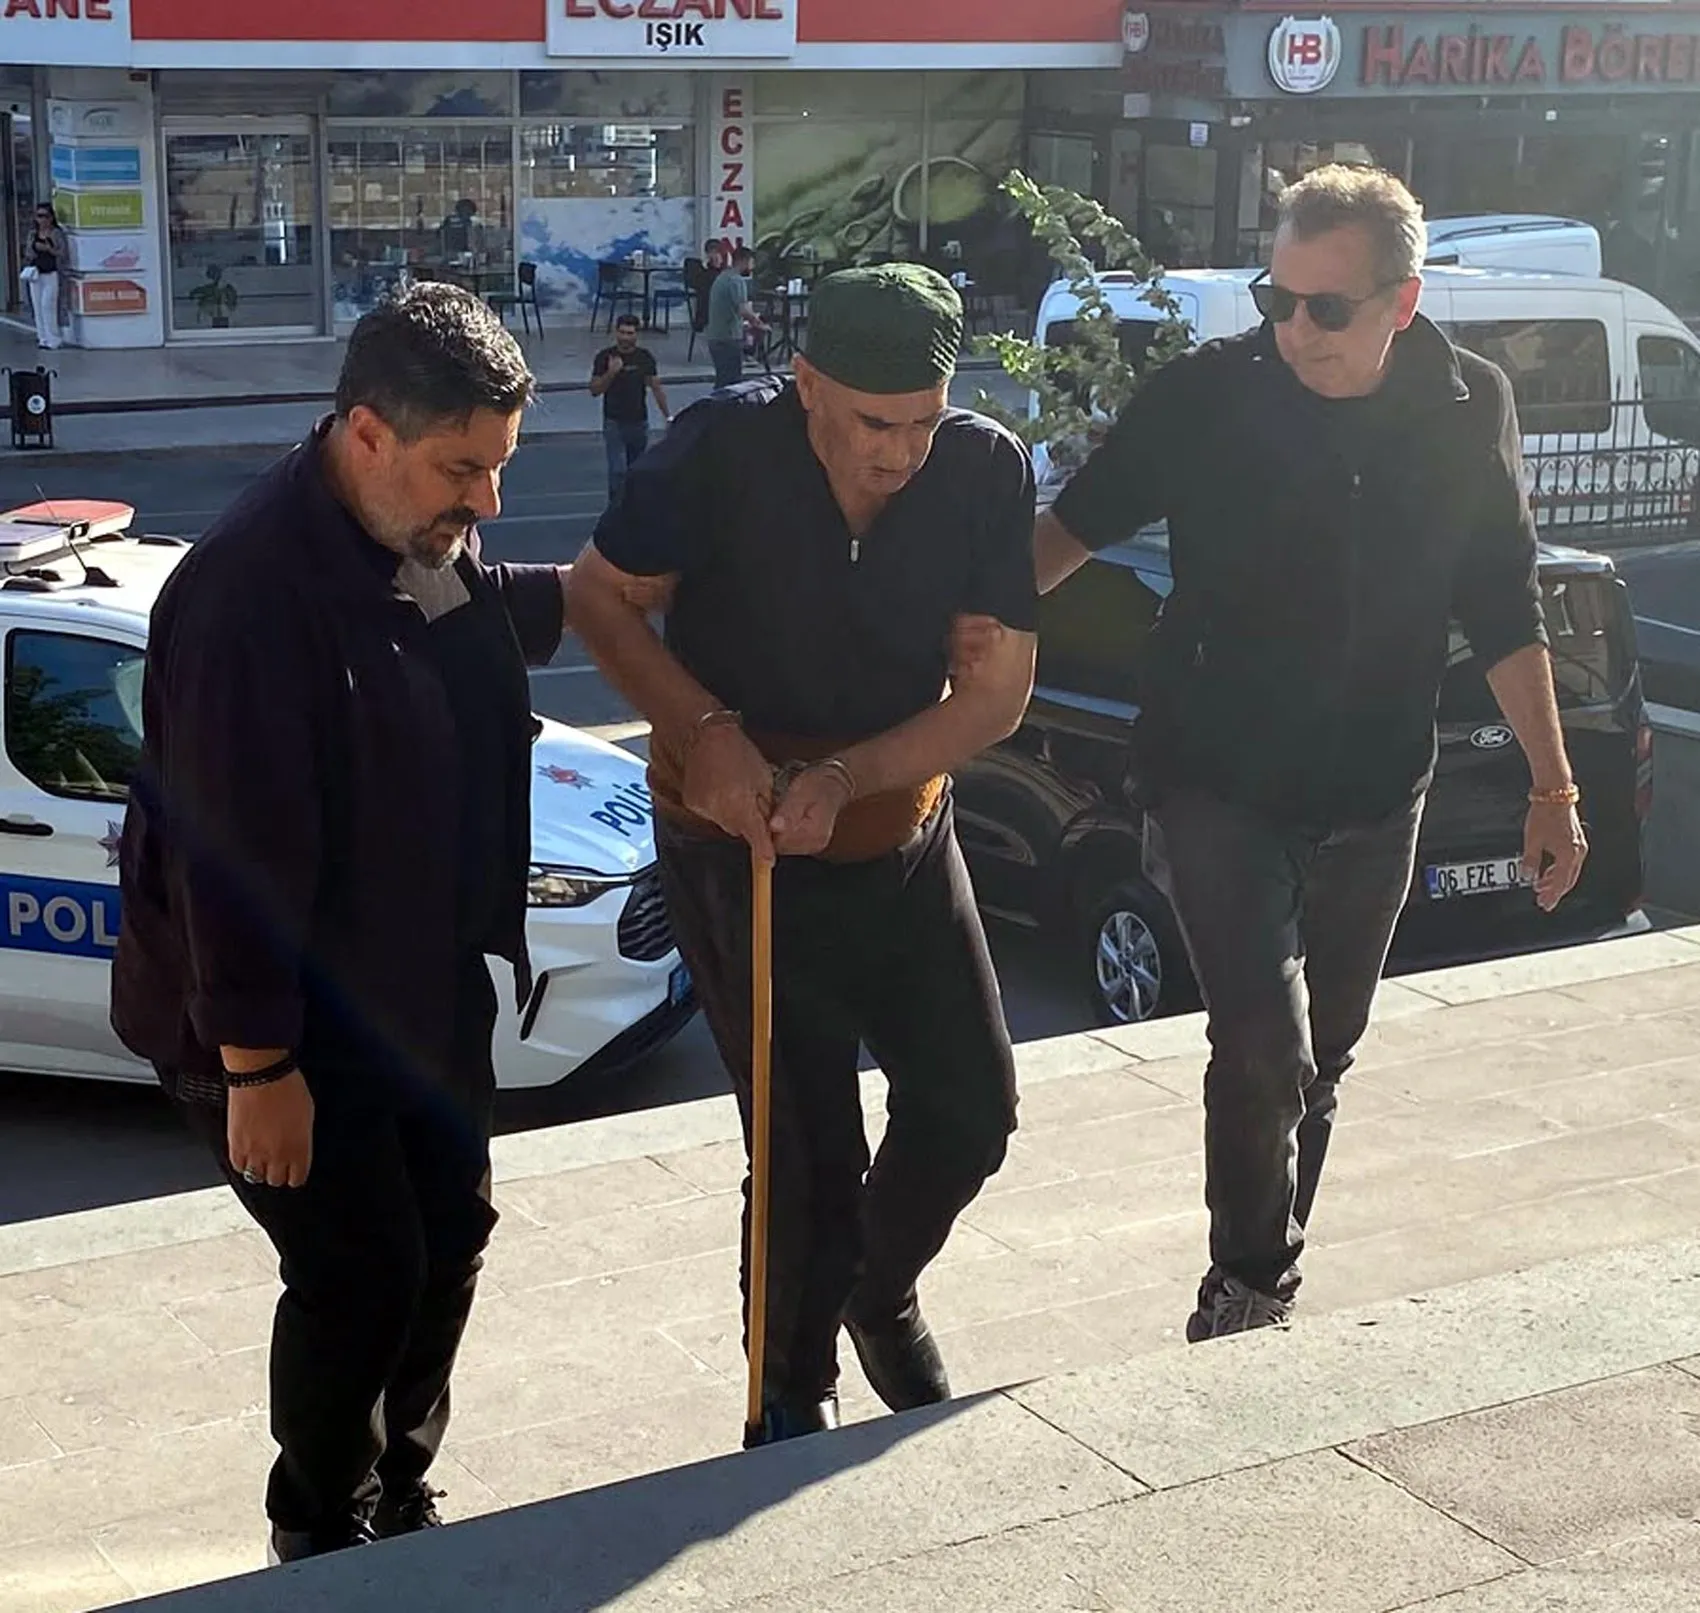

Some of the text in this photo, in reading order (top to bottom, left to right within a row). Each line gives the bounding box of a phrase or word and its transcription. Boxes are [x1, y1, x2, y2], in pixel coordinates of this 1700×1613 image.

[646, 22, 705, 52] IŞIK
[1288, 34, 1322, 65] HB
[1361, 21, 1700, 86] HARİKA BÖRE
[1437, 860, 1526, 893] 06 FZE 0
